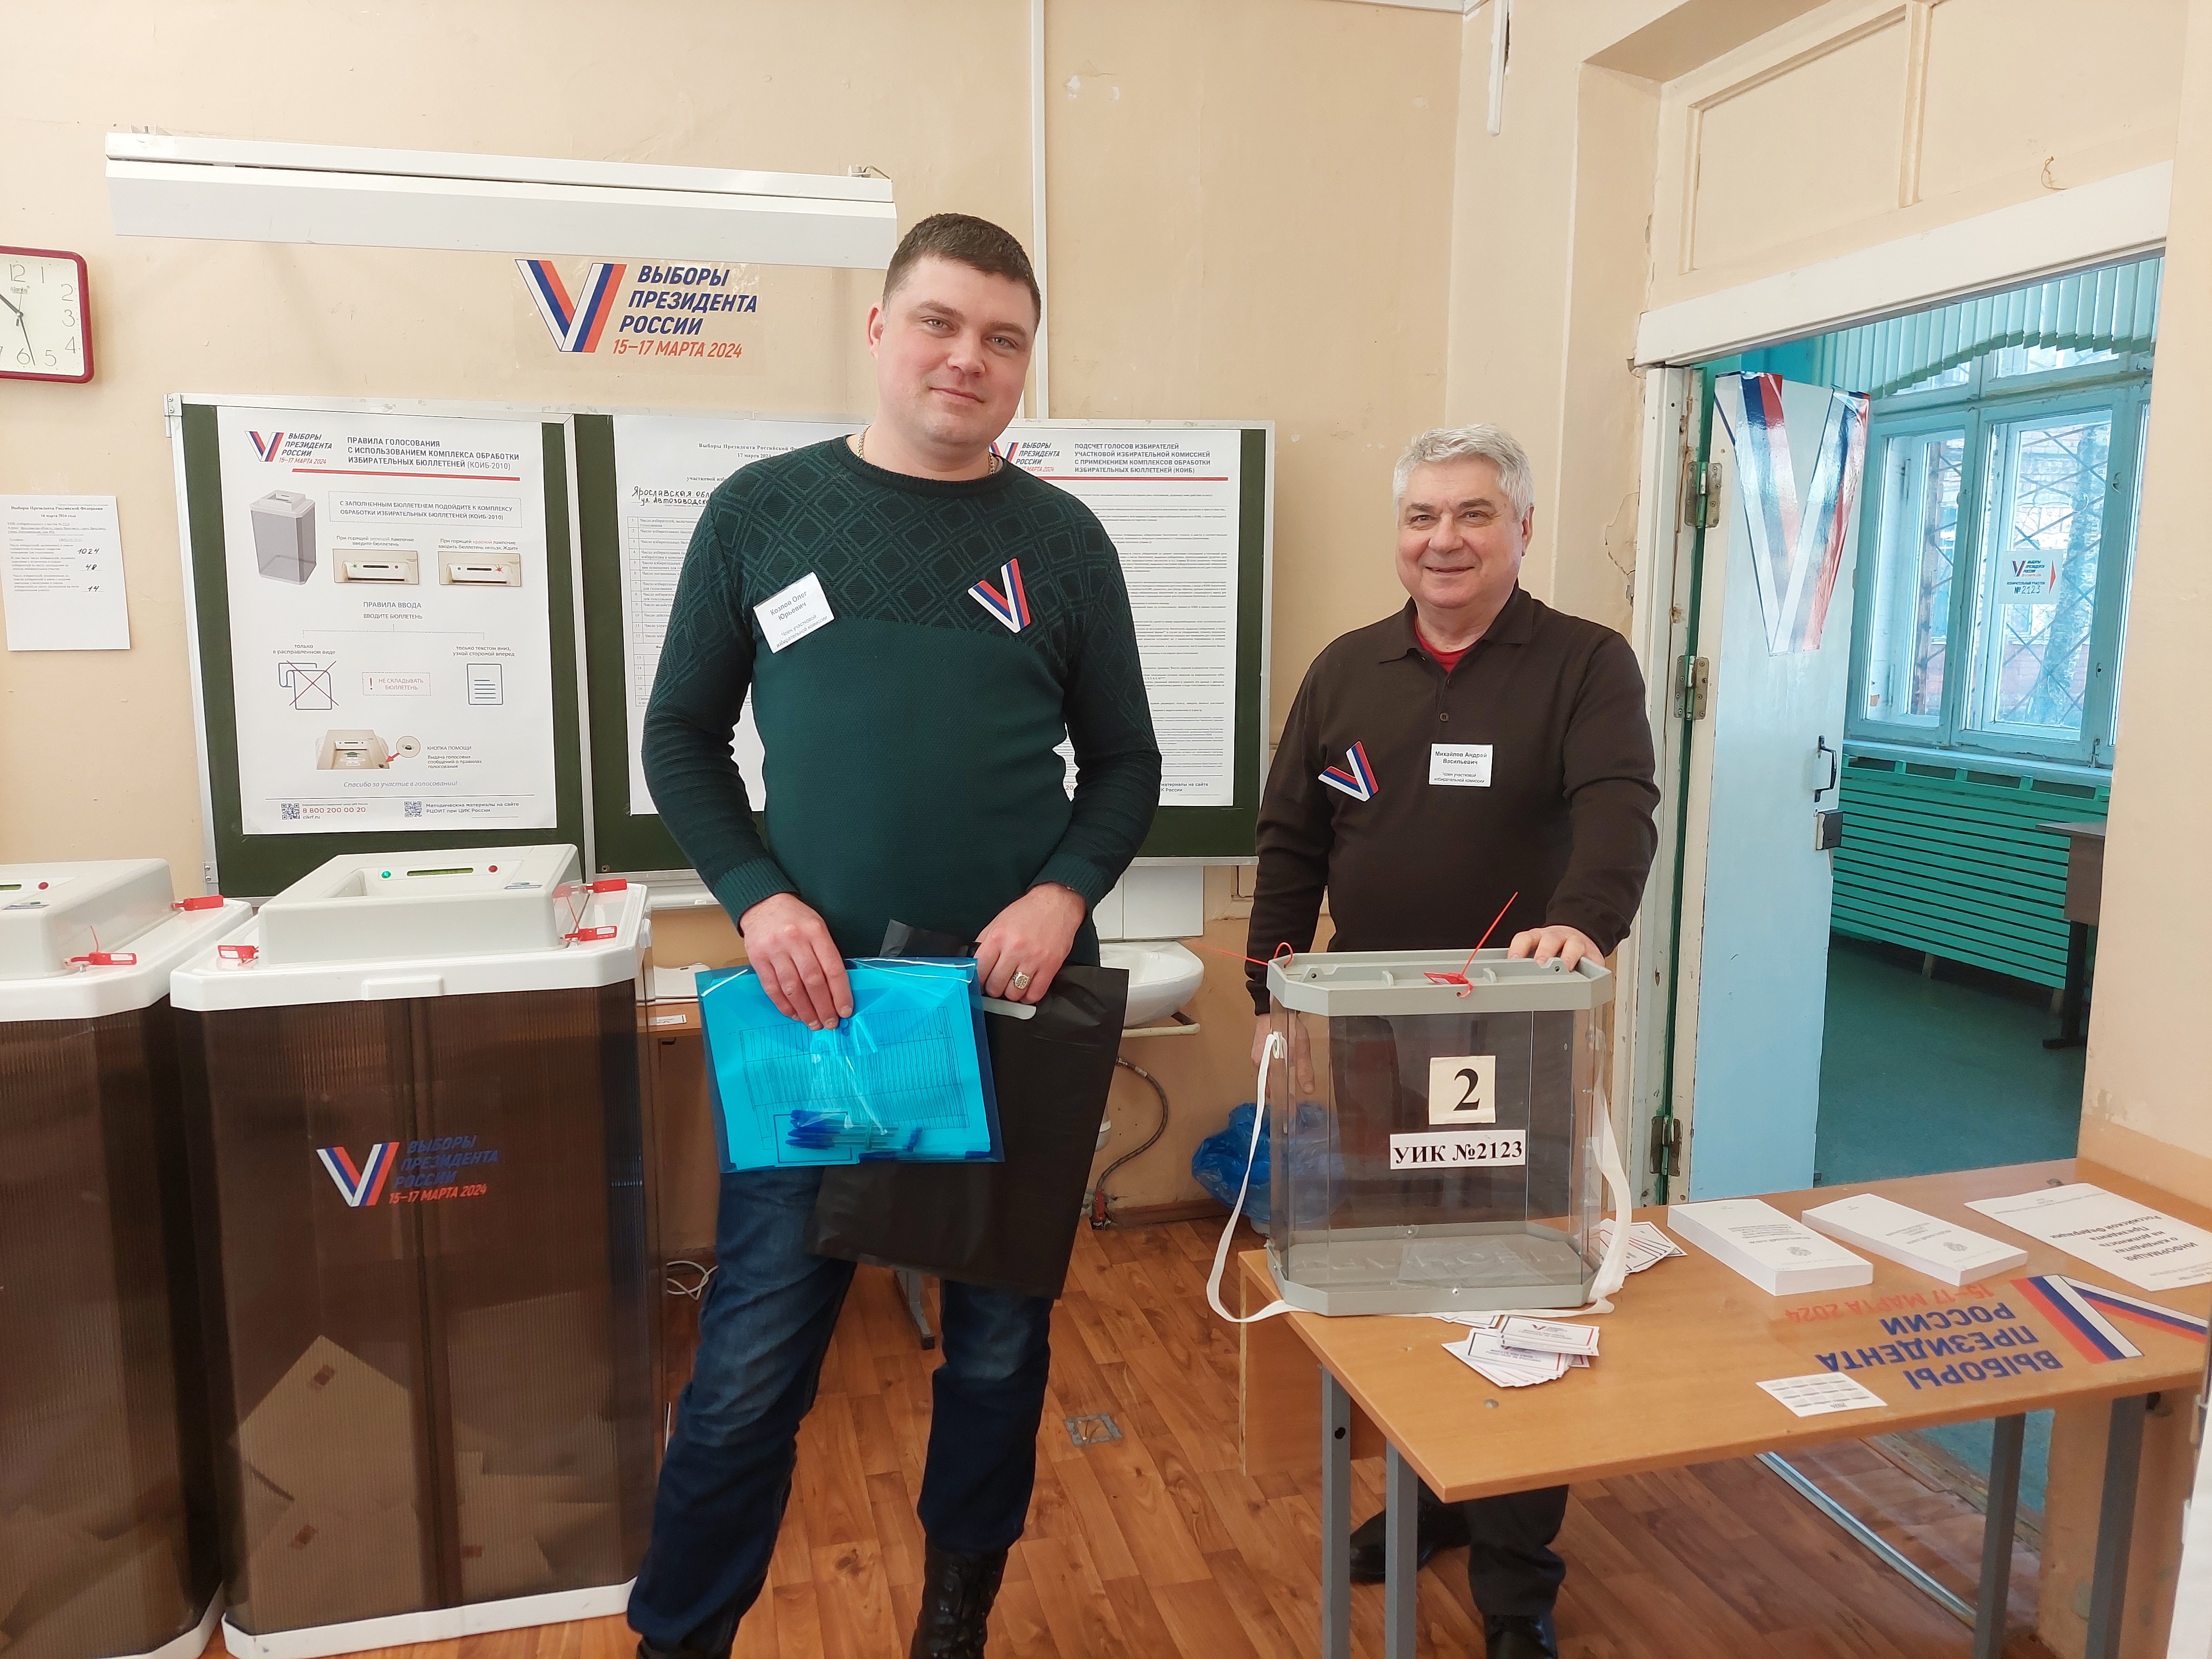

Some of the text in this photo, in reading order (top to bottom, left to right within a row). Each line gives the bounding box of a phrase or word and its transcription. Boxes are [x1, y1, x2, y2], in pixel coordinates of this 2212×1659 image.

[10, 264, 26, 282] 12
[637, 265, 730, 287] ВЫБОРЫ
[61, 283, 74, 301] 2
[628, 290, 757, 313] ПРЕЗИДЕНТА
[62, 309, 75, 327] 3
[619, 315, 703, 335] РОССИИ
[65, 336, 77, 354] 4
[655, 341, 705, 357] МАРТА
[707, 342, 742, 358] 2024
[17, 348, 30, 365] 6
[44, 350, 56, 366] 5
[285, 441, 332, 449] ПРЕЗИДЕНТА
[347, 437, 440, 447] ПРАВИЛА ГОЛОСОВАНИЯ
[354, 447, 427, 456] ИСПОЛЬЗОВАНИЕМ
[429, 450, 474, 459] КОМПЛЕКСА
[476, 452, 520, 460] ОБРАБОТКИ
[348, 456, 511, 471] ИЗБИРАТЕЛЬНЫХ БЮЛЛЕТЕНЕЙ (КОИБ-2010)
[631, 486, 692, 500] Ярославская
[770, 591, 807, 616] Козлов Олег
[778, 602, 807, 621] Юрьевич
[1452, 1068, 1481, 1111] 2
[408, 1135, 477, 1154] ВЫБОРЫ
[1392, 1140, 1522, 1164] УИК №2123
[400, 1150, 499, 1171] ПРЕЗИДЕНТА
[394, 1171, 457, 1190] РОССИИ
[420, 1183, 487, 1201] МАРТА 2024
[2123, 1242, 2199, 1261] ИНФОРМАЦИЯ
[1785, 1292, 1928, 1325] МАРТА 2024
[1879, 1302, 2016, 1336] РОССИИ
[1814, 1326, 2039, 1372] ПРЕЗИДЕНТА
[1902, 1350, 2064, 1390] ВЫБОРЫ
